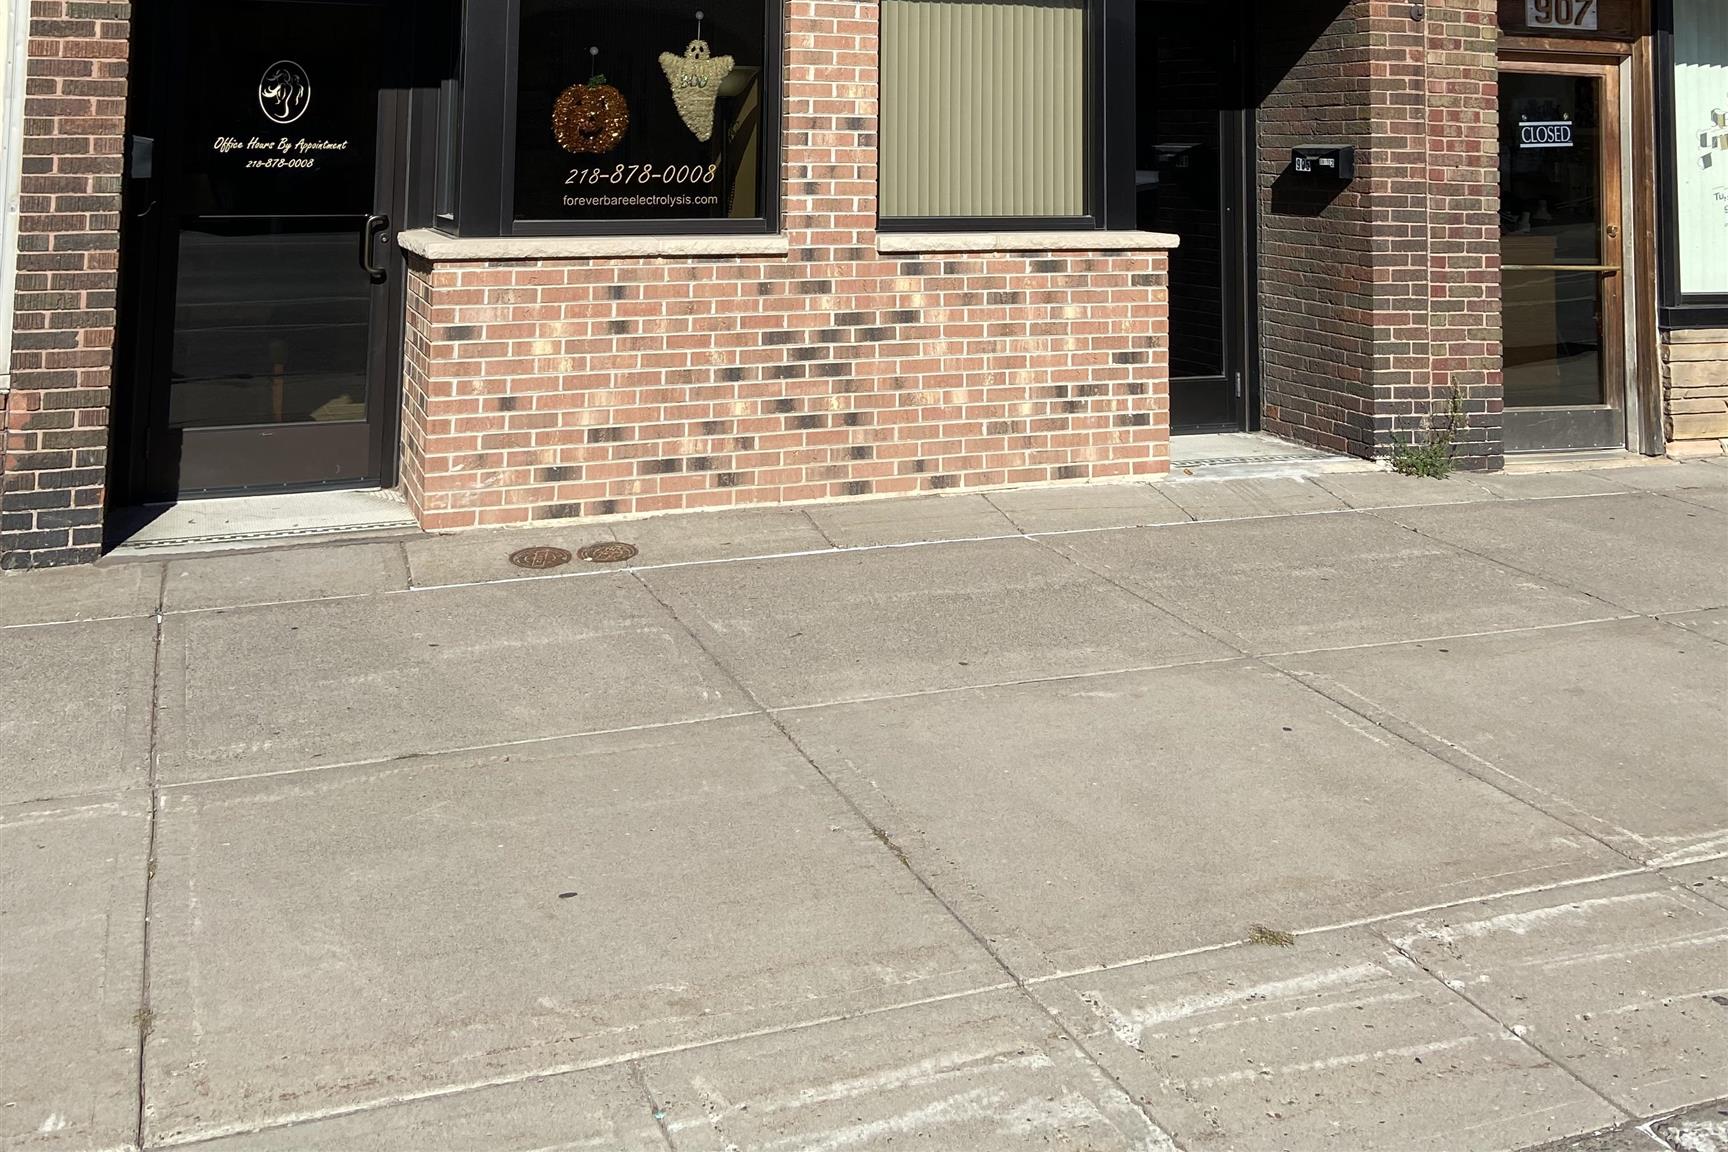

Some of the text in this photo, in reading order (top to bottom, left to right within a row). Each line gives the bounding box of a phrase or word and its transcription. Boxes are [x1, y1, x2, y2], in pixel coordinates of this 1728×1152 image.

[1521, 126, 1571, 143] CLOSED
[213, 136, 349, 154] Office Hours By Appointment
[245, 157, 315, 169] 218-878-0008
[564, 163, 718, 185] 218-878-0008
[562, 194, 719, 208] foreverbareelectrolysis.com
